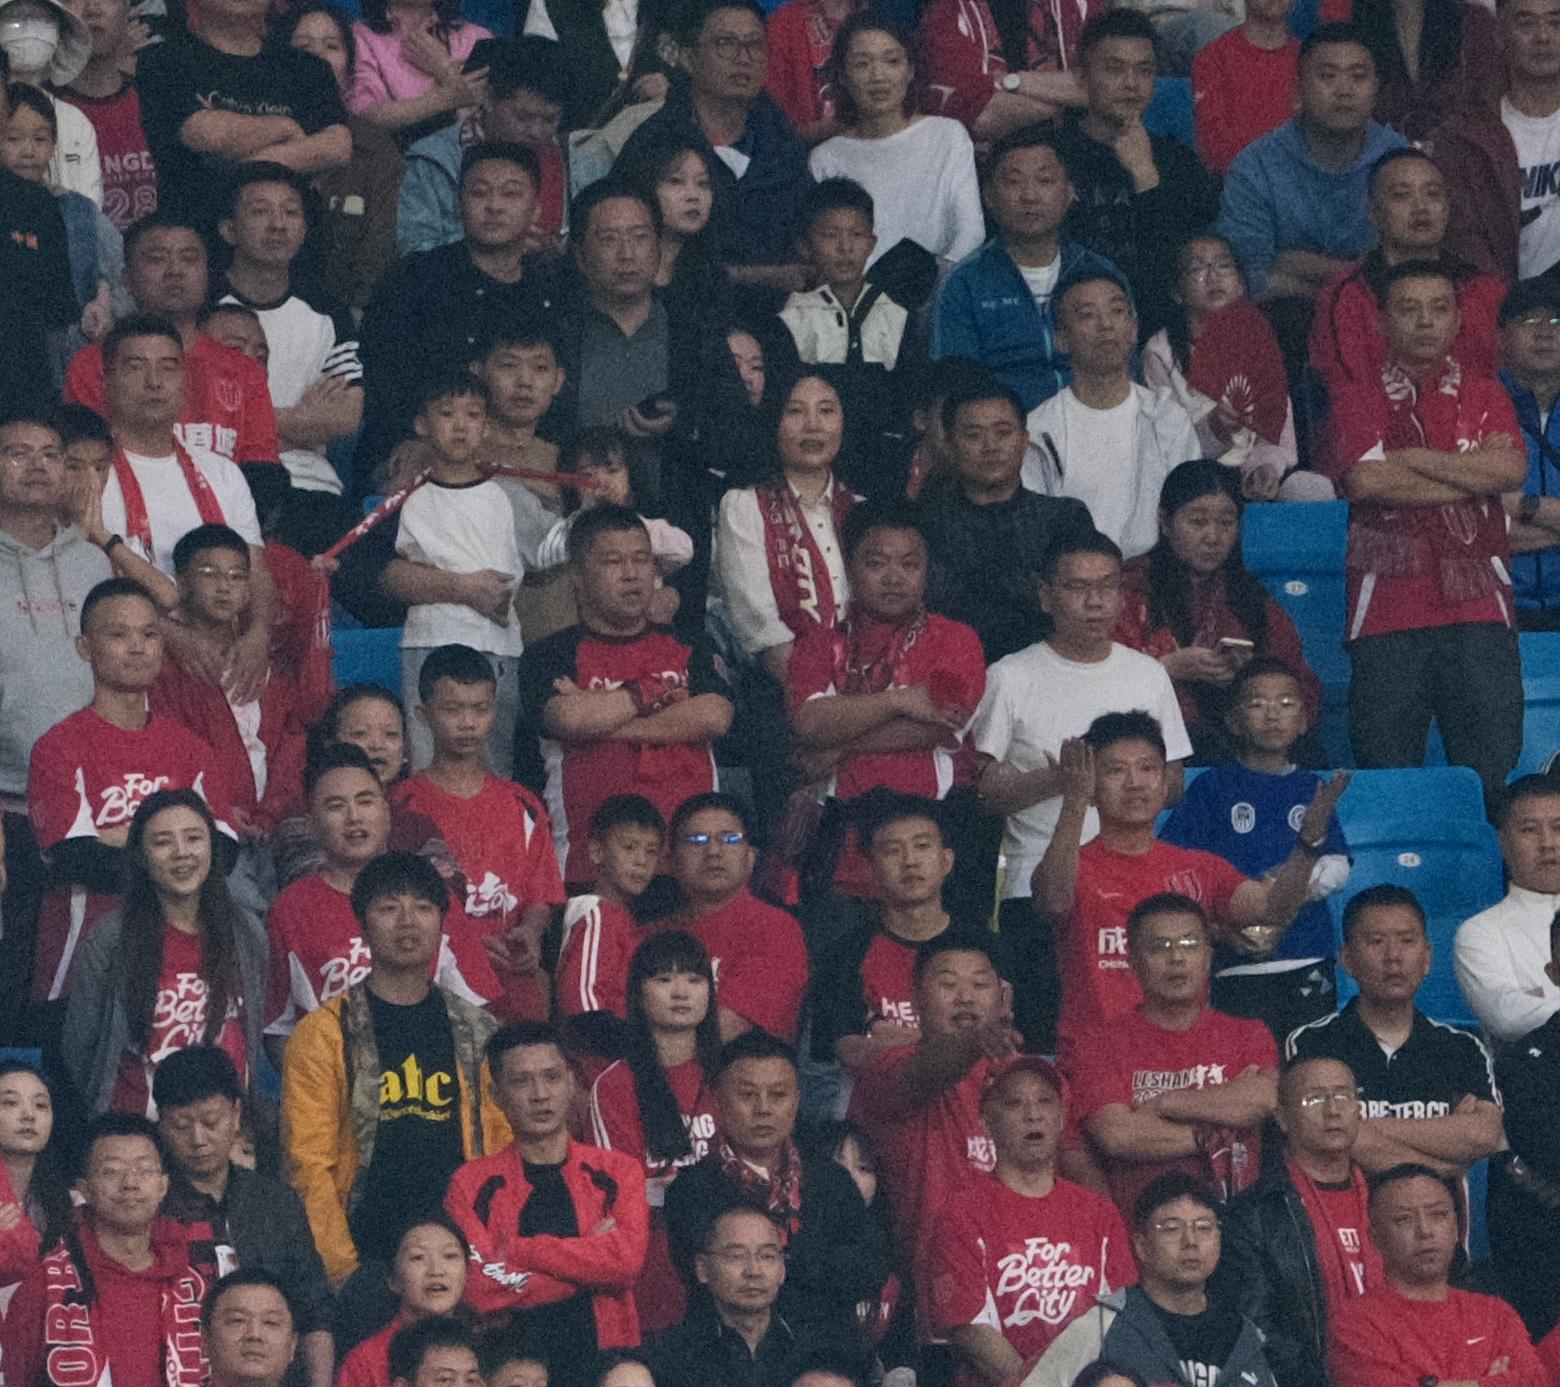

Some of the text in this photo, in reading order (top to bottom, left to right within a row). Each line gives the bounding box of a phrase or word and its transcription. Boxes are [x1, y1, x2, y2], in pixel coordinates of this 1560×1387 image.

[125, 774, 170, 801] For
[1025, 1237, 1070, 1262] For
[996, 1254, 1096, 1298] Better
[1004, 1281, 1077, 1331] City
